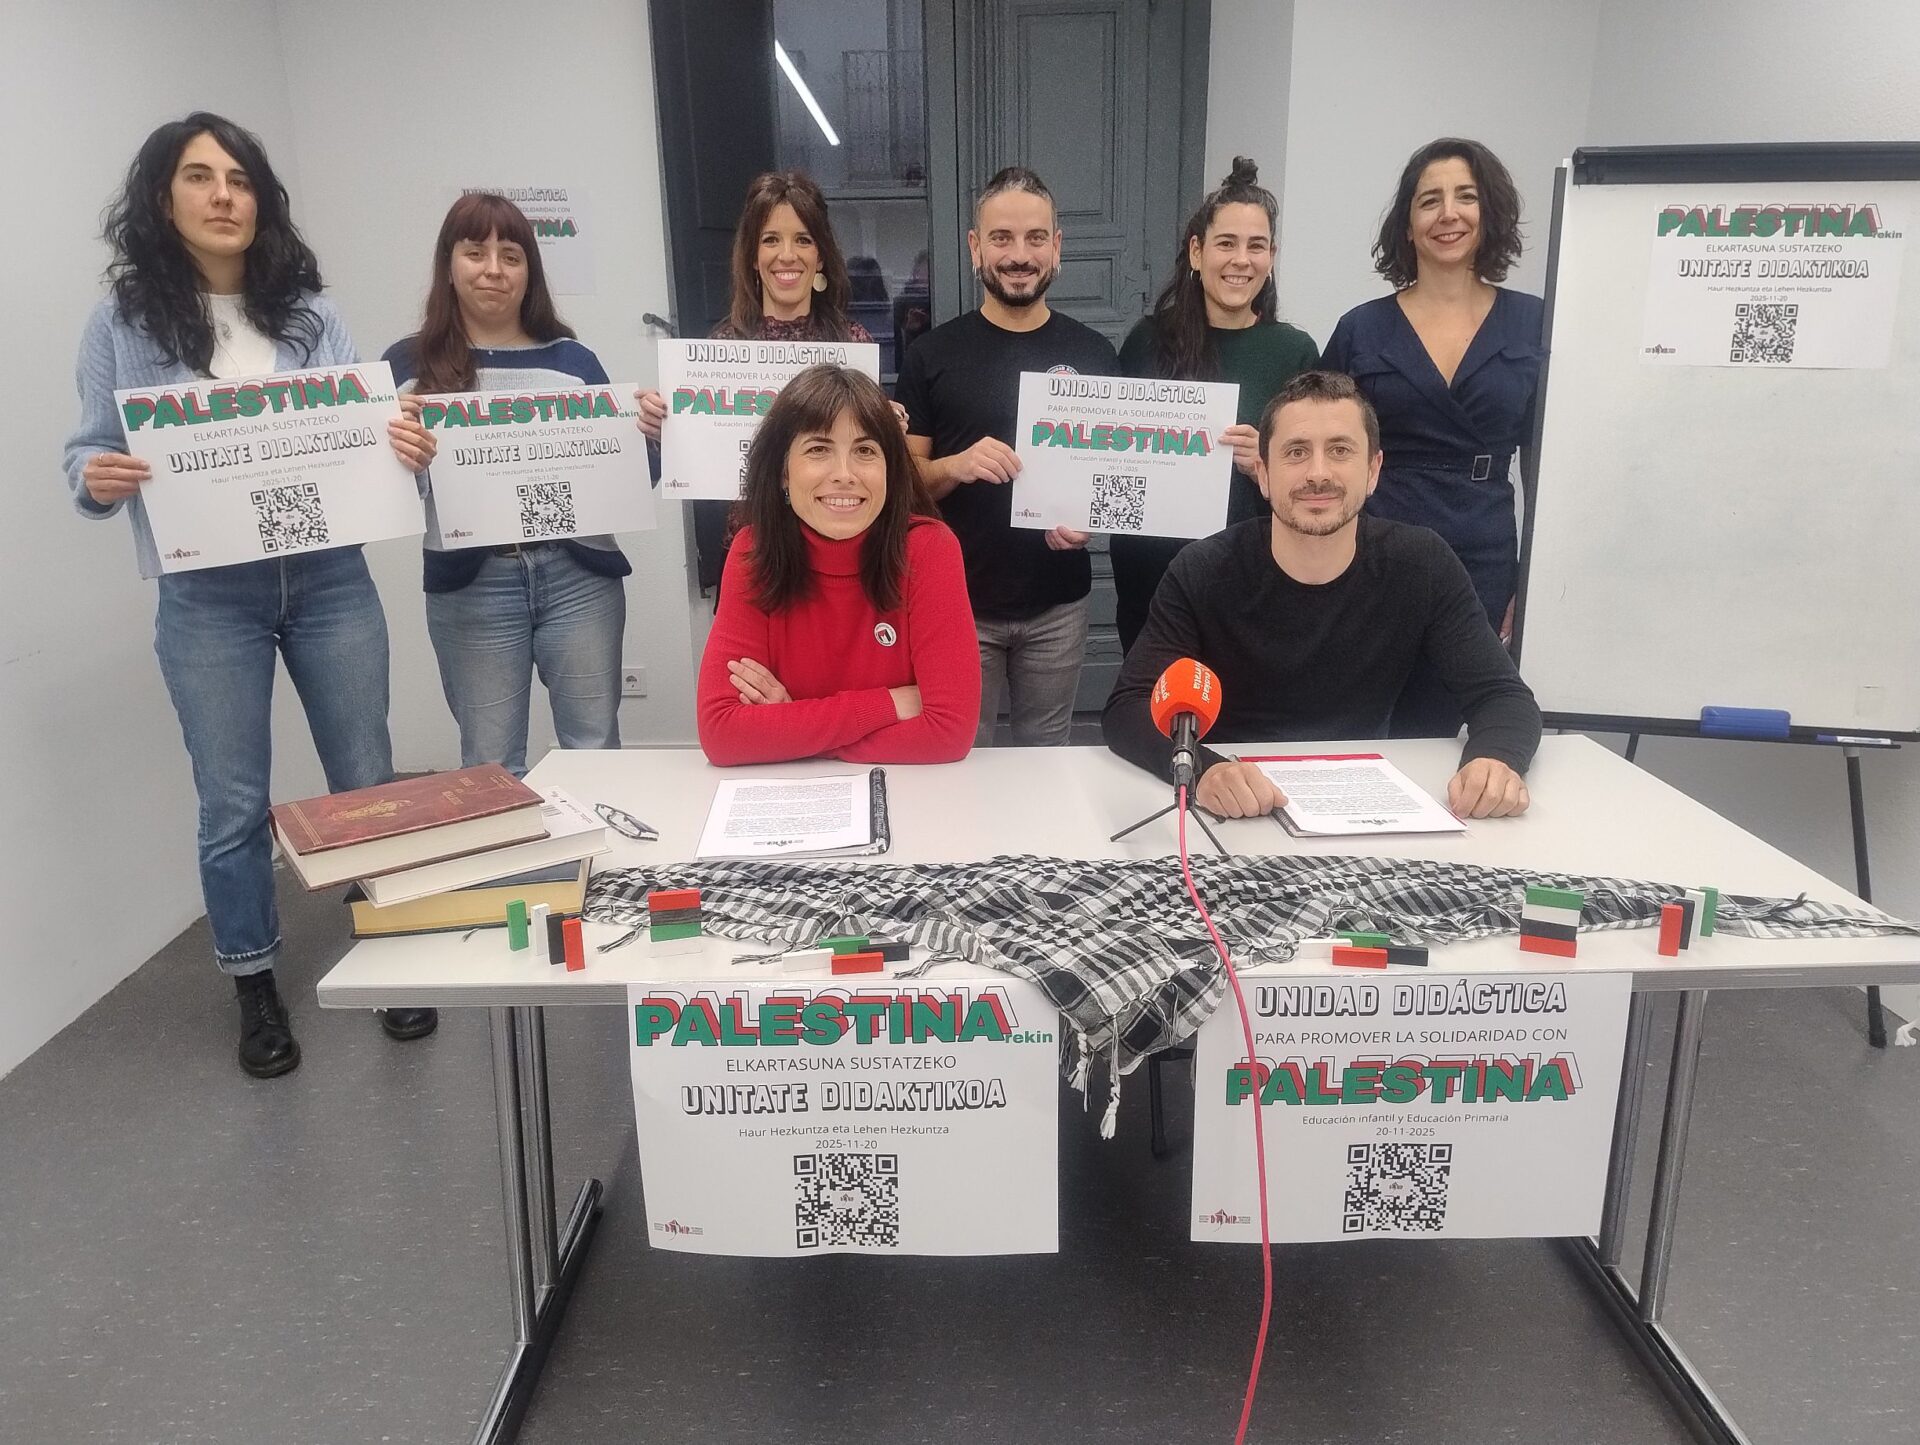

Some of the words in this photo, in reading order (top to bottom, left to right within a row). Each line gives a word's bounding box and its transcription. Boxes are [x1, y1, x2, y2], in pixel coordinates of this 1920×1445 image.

[1657, 203, 1882, 237] PALESTINA
[1706, 244, 1776, 253] ELKARTASUNA
[1779, 244, 1842, 253] SUSTATZEKO
[1678, 259, 1750, 277] UNITATE
[1758, 260, 1869, 278] DIDAKTIKOA
[686, 344, 750, 363] UNIDAD
[757, 345, 847, 365] DIDÁCTICA
[687, 371, 708, 379] PARA
[710, 371, 757, 380] PROMOVER
[122, 369, 373, 431] PALESTINA
[672, 385, 780, 416] PALES
[1049, 379, 1111, 399] UNIDAD
[1118, 382, 1206, 404] DIDÁCTICA
[421, 388, 621, 430] PALESTINA
[1048, 405, 1068, 413] PARA
[1071, 406, 1117, 416] PROMOVER
[1131, 409, 1186, 419] SOLIDARIDAD
[1188, 412, 1206, 420] CON
[194, 422, 271, 442] ELKARTASUNA
[272, 415, 340, 430] SUSTATZEKO
[475, 430, 537, 441] ELKARTASUNA
[539, 426, 593, 437] SUSTATZEKO
[1032, 418, 1214, 457] PALESTINA
[167, 443, 252, 473] UNITATE
[260, 427, 377, 462] DIDAKTIKOA
[453, 444, 521, 466] UNITATE
[526, 437, 621, 461] DIDAKTIKOA
[211, 476, 229, 485] Haur
[232, 470, 269, 482] Hezkuntza
[271, 468, 283, 476] eta
[284, 464, 306, 475] Lehen
[308, 459, 345, 472] Hezkuntza
[262, 475, 302, 487] 2025-11-20
[527, 474, 559, 482] 2025-11-20
[1255, 985, 1379, 1017] UNIDAD
[1393, 979, 1567, 1016] DIDÁCTICA
[635, 986, 1020, 1047] PALESTINA
[1004, 1030, 1053, 1045] rekin
[1255, 1033, 1296, 1045] PARA
[1301, 1030, 1391, 1044] PROMOVER
[1396, 1030, 1415, 1043] LA
[1420, 1029, 1527, 1043] SOLIDARIDAD
[1531, 1028, 1567, 1041] CON
[726, 1057, 846, 1072] ELKARTASUNA
[850, 1055, 957, 1070] SUSTATZEKO
[1226, 1052, 1584, 1106] PALESTINA
[681, 1083, 809, 1115] UNITATE
[821, 1079, 1007, 1111] DIDAKTIKOA
[739, 1127, 766, 1137] Haur
[770, 1125, 829, 1136] Hezkuntza
[832, 1125, 850, 1134] eta
[853, 1124, 888, 1134] Lehen
[890, 1124, 950, 1135] Hezkuntza
[1303, 1114, 1355, 1126] Educación
[1359, 1113, 1395, 1124] infantil
[1397, 1116, 1403, 1125] y
[1407, 1113, 1461, 1125] Educación
[1464, 1112, 1509, 1123] Primaria
[1376, 1127, 1435, 1137] 20-11-2025
[815, 1139, 878, 1149] 2025-11-20
